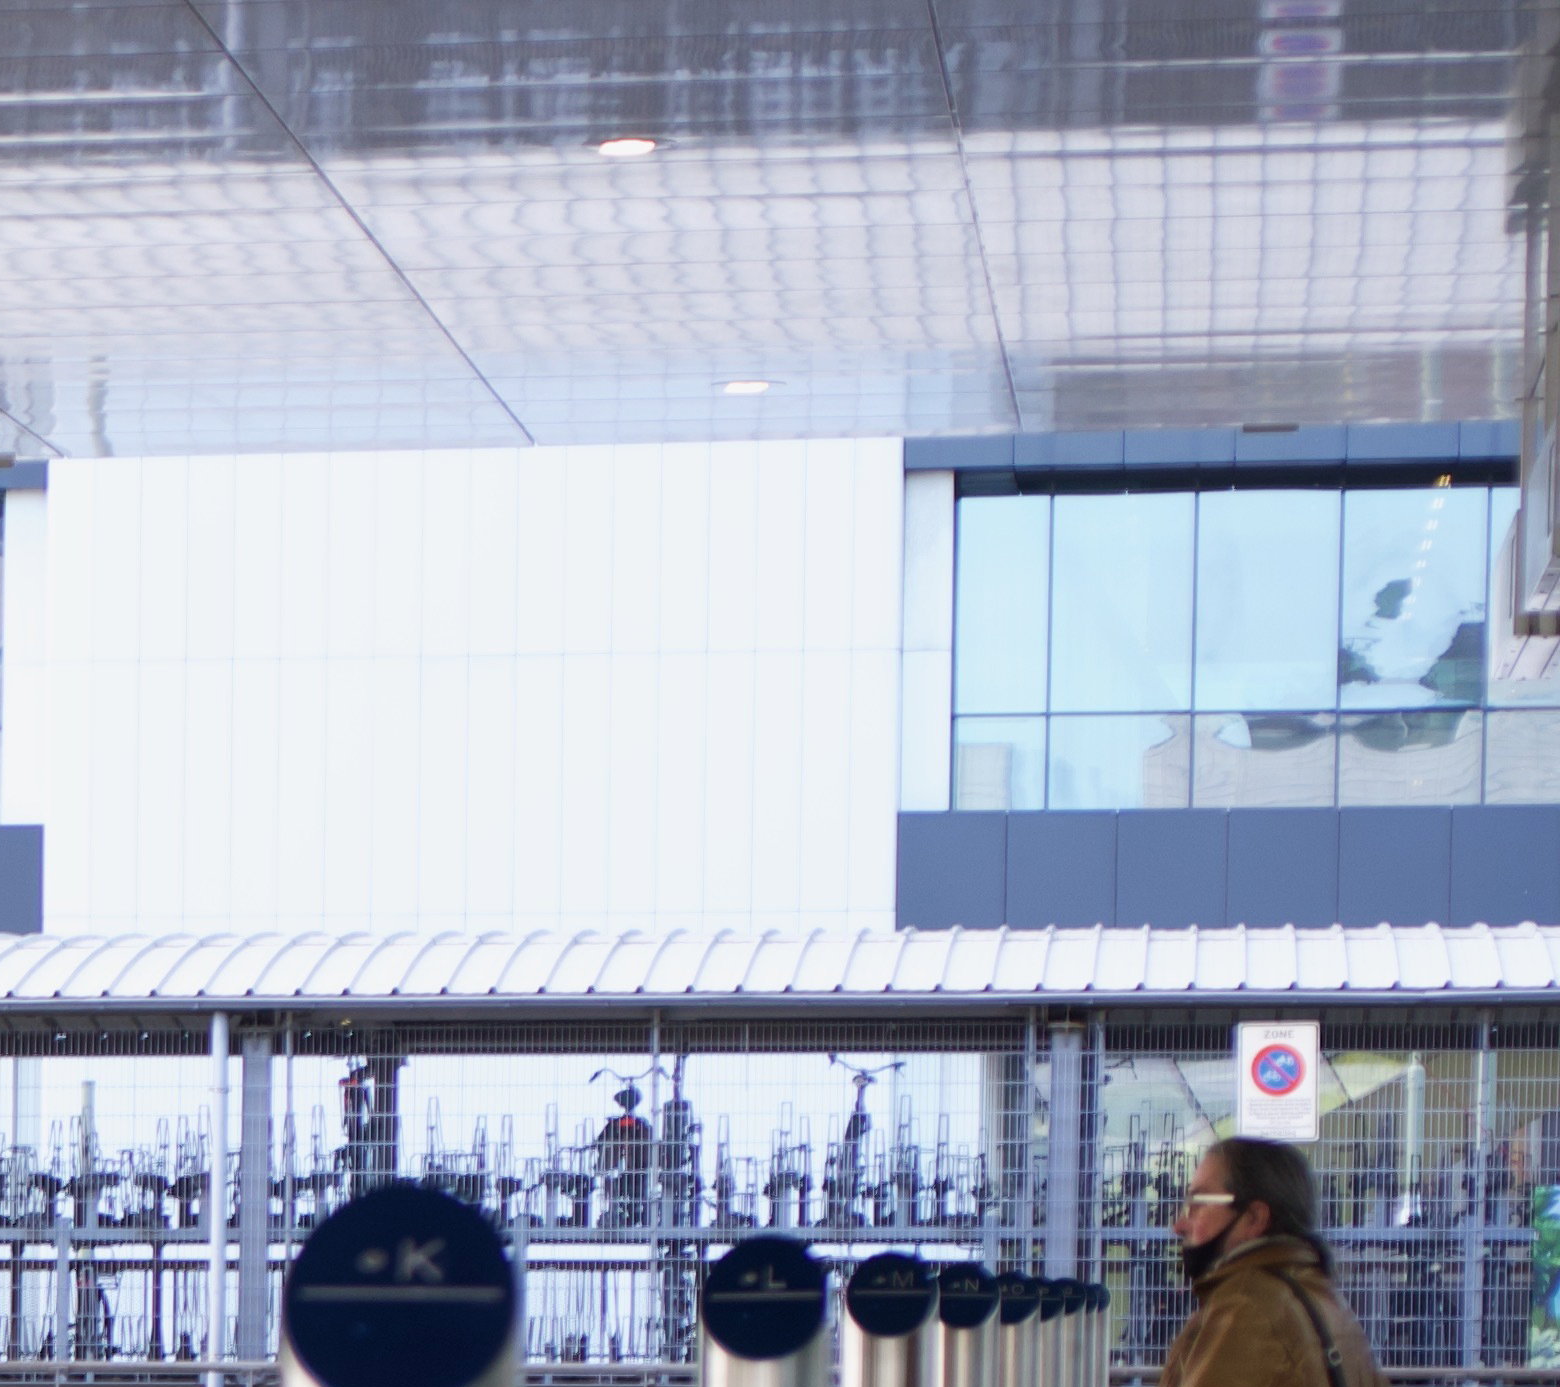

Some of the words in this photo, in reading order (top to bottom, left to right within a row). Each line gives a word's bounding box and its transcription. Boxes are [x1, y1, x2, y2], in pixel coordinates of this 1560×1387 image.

[1263, 1029, 1296, 1040] ZONE
[396, 1237, 446, 1281] K
[763, 1265, 787, 1289] L
[892, 1270, 915, 1288] M
[962, 1278, 980, 1292] N
